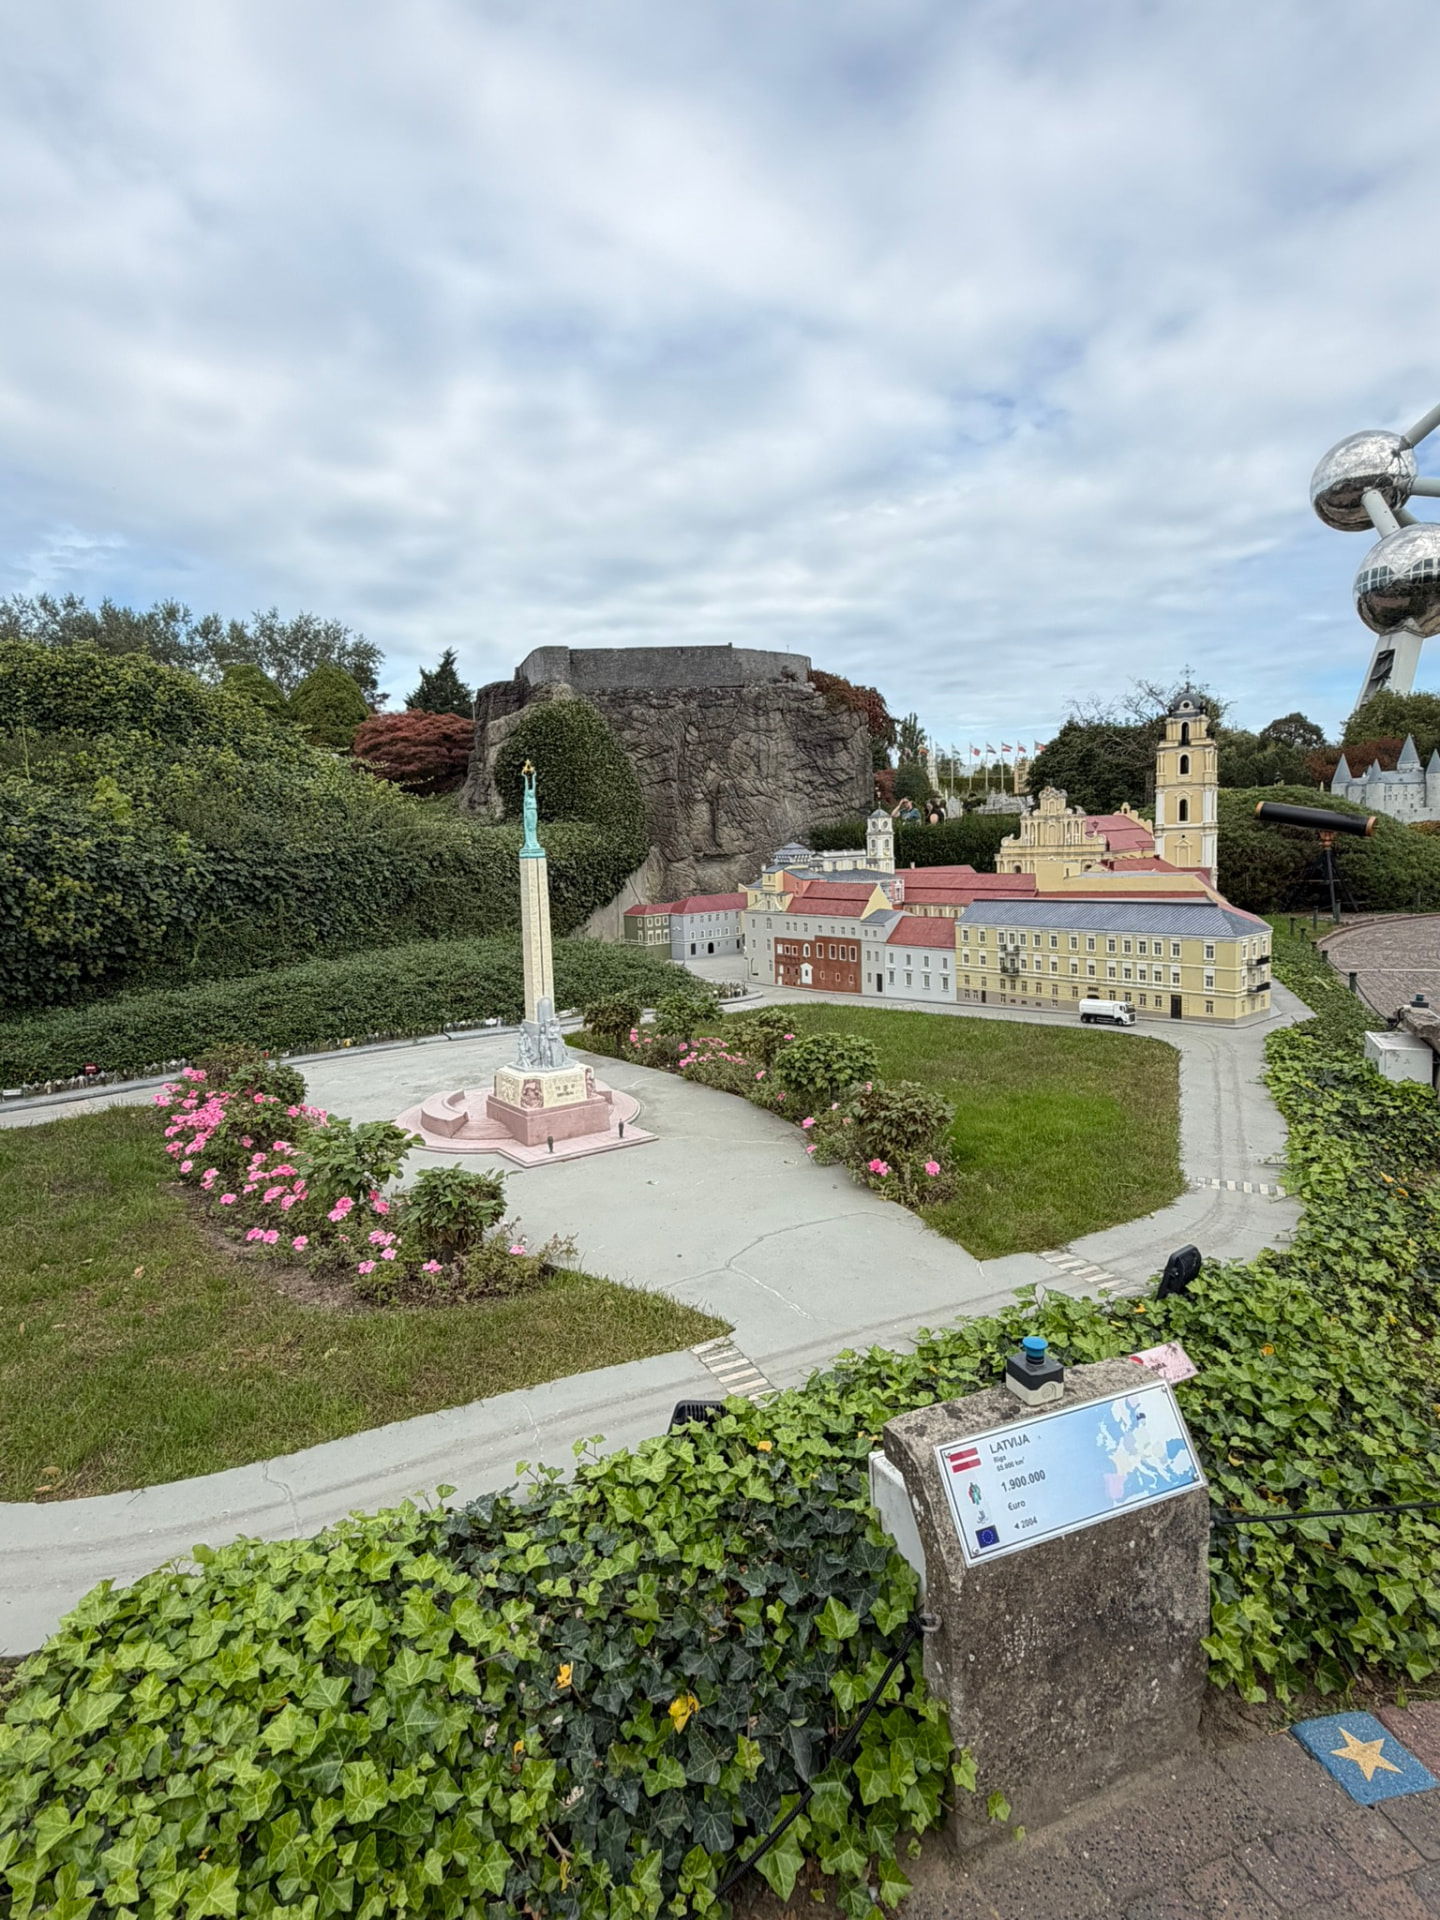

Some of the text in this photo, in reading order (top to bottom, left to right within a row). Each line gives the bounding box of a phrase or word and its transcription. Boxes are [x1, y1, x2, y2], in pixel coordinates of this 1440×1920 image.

[989, 1434, 1030, 1454] LATVIJA
[1001, 1469, 1046, 1493] 1.900.000
[1020, 1516, 1038, 1529] 2004
